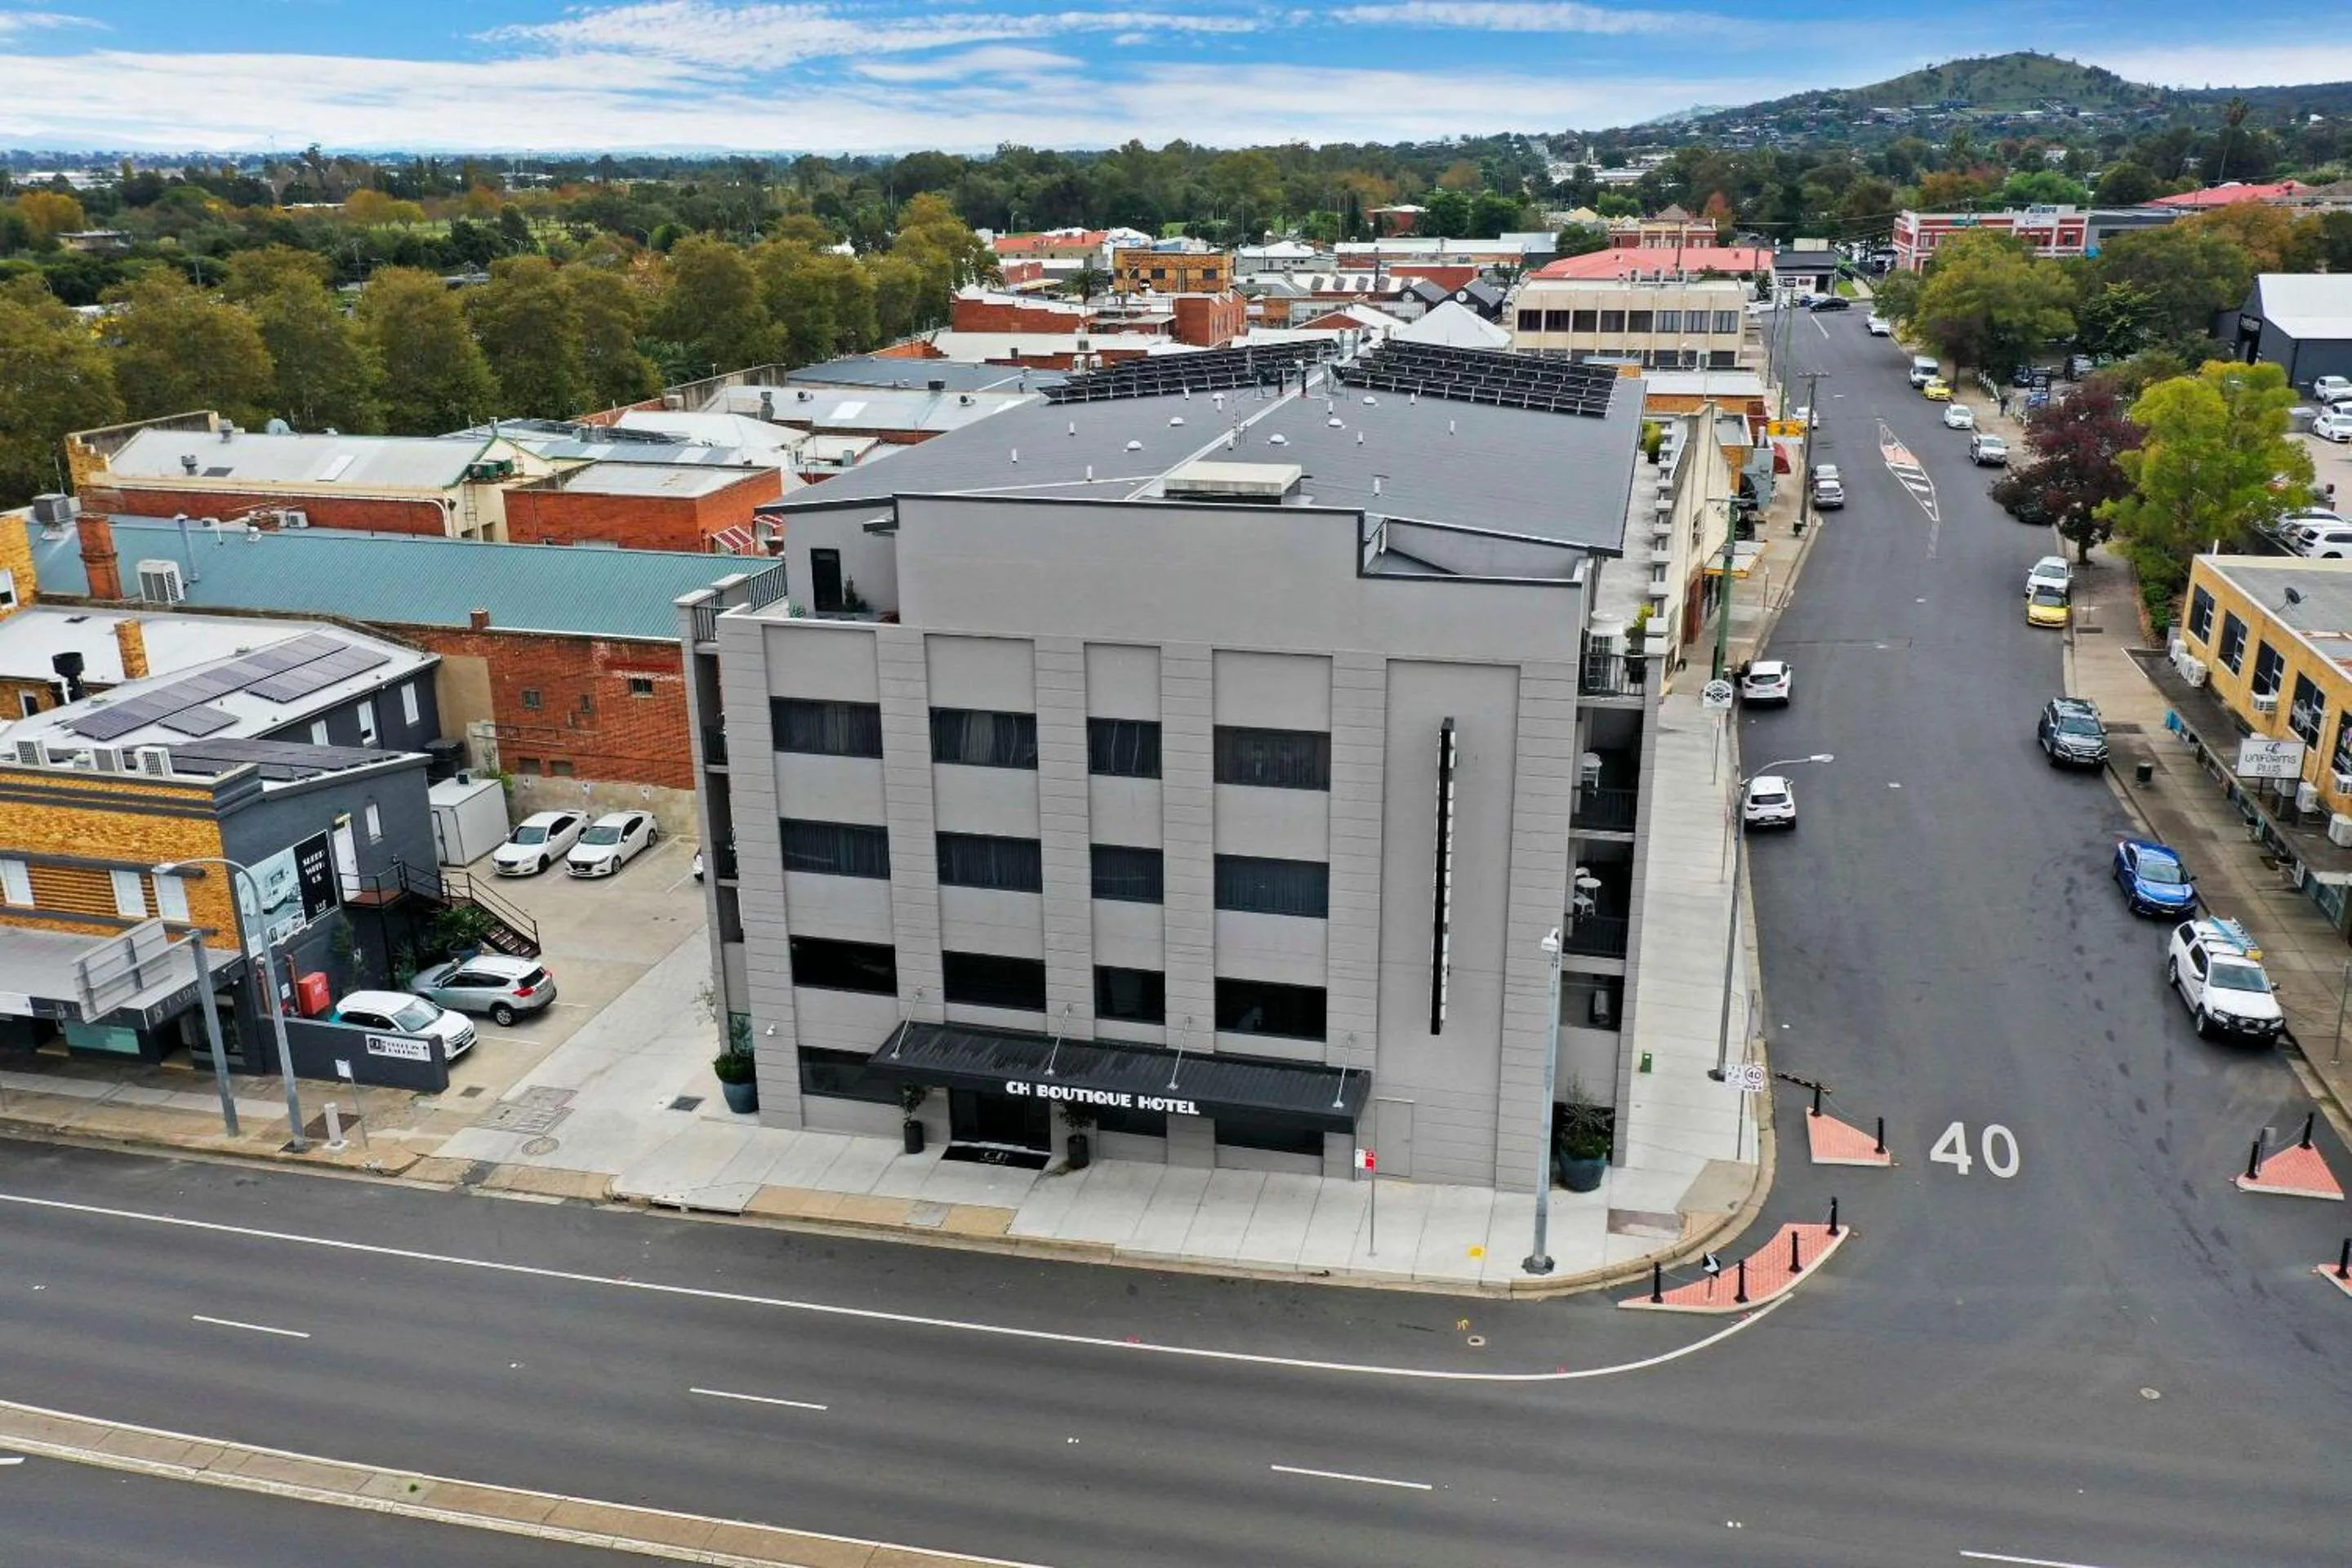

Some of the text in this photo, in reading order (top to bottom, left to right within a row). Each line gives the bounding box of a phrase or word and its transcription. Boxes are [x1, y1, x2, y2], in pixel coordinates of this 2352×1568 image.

[1748, 1071, 1762, 1080] 40
[1005, 1081, 1200, 1116] CH BOUTIQUE HOTEL
[1930, 1121, 2020, 1178] 40
